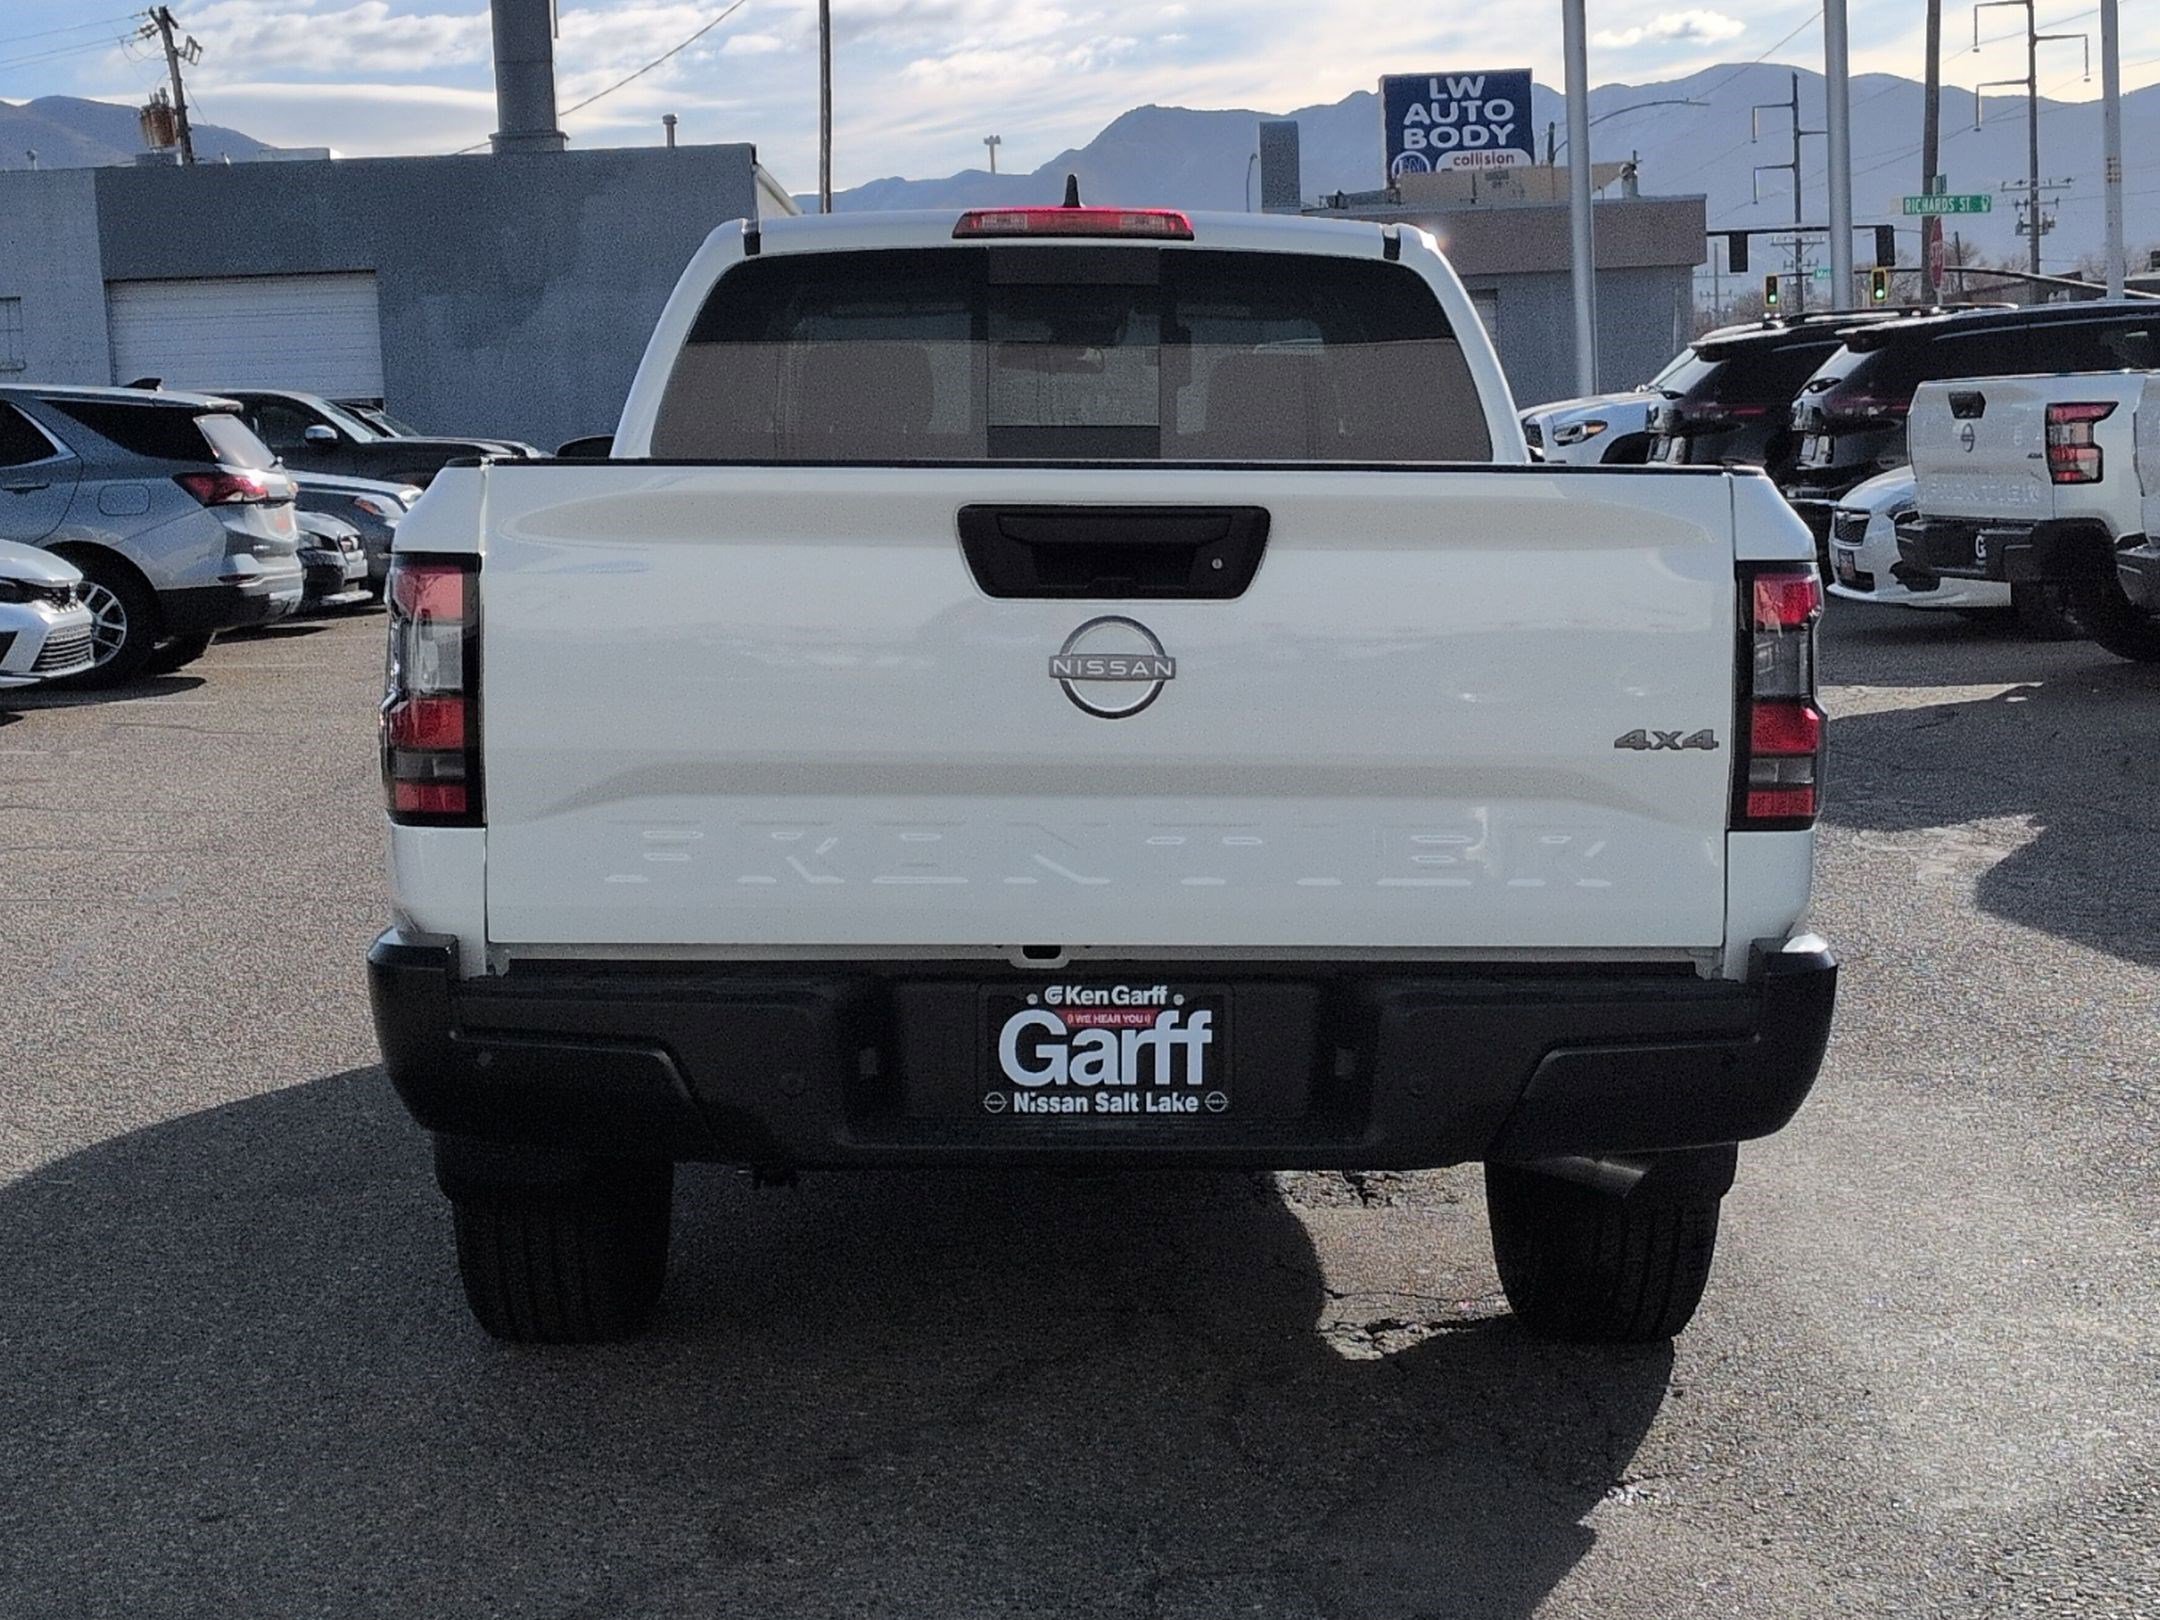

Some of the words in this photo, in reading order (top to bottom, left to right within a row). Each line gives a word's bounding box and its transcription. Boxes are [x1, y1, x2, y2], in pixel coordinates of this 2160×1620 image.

[1429, 76, 1486, 99] LW
[1403, 99, 1515, 126] AUTO
[1403, 123, 1515, 149] BODY
[1453, 152, 1515, 167] collision
[1904, 198, 1955, 213] RICHARDS
[1052, 659, 1172, 676] NISSAN
[1066, 985, 1107, 1005] Ken
[1111, 985, 1168, 1005] Garff
[1075, 1014, 1092, 1024] WE
[1093, 1014, 1121, 1024] HEAR
[1122, 1014, 1143, 1024] YOU
[998, 1009, 1213, 1087] Garff
[1013, 1092, 1089, 1113] Nissan
[1095, 1092, 1139, 1113] Salt
[1146, 1091, 1199, 1113] Lake
